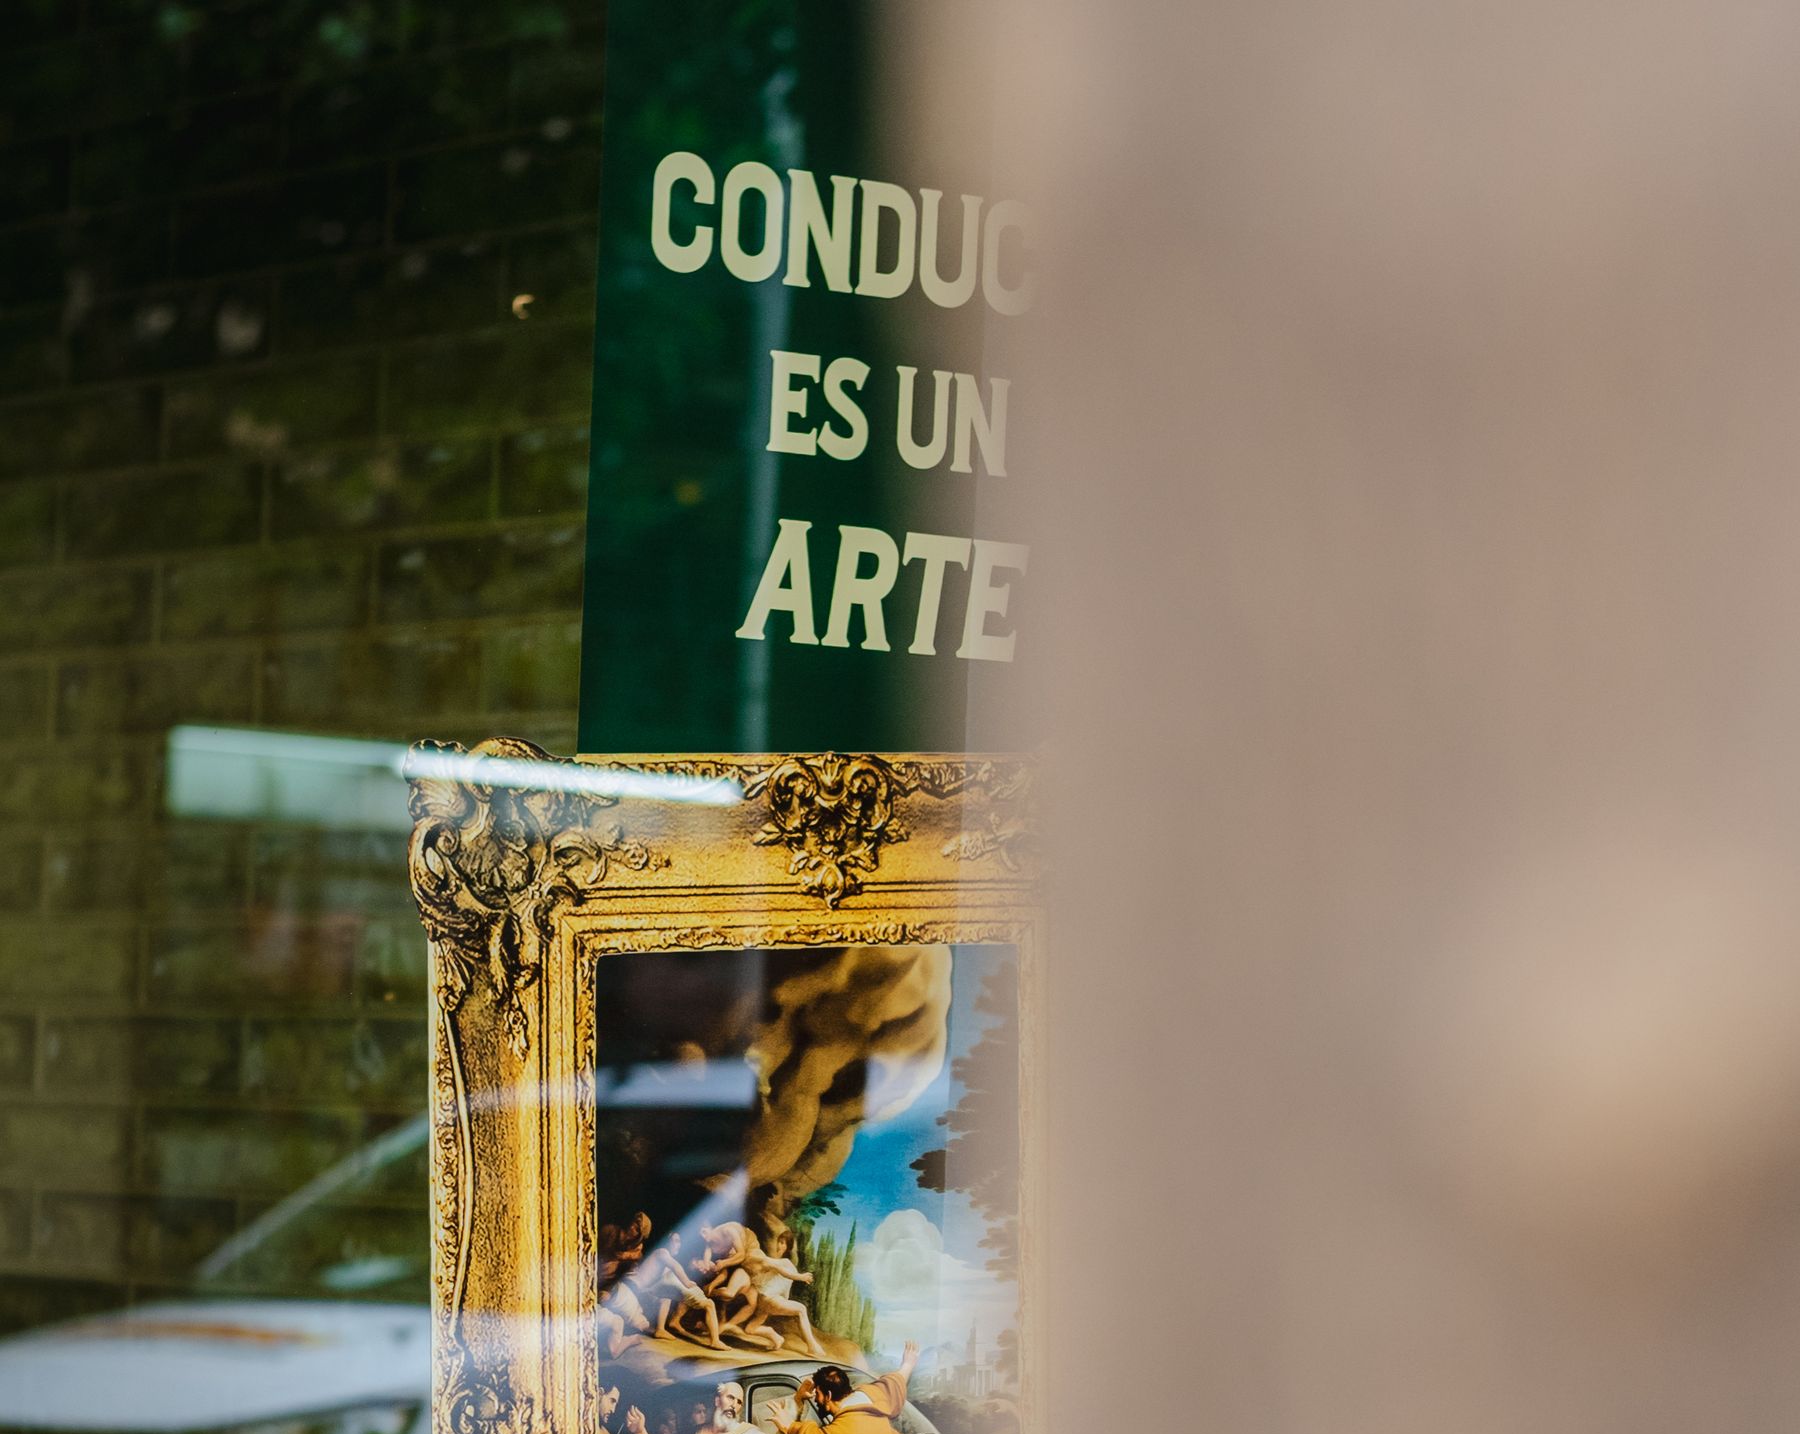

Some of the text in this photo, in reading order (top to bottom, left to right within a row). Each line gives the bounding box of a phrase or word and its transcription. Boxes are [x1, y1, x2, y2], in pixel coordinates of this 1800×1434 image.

[766, 349, 1012, 477] ES UN
[735, 518, 1030, 662] ARTE
